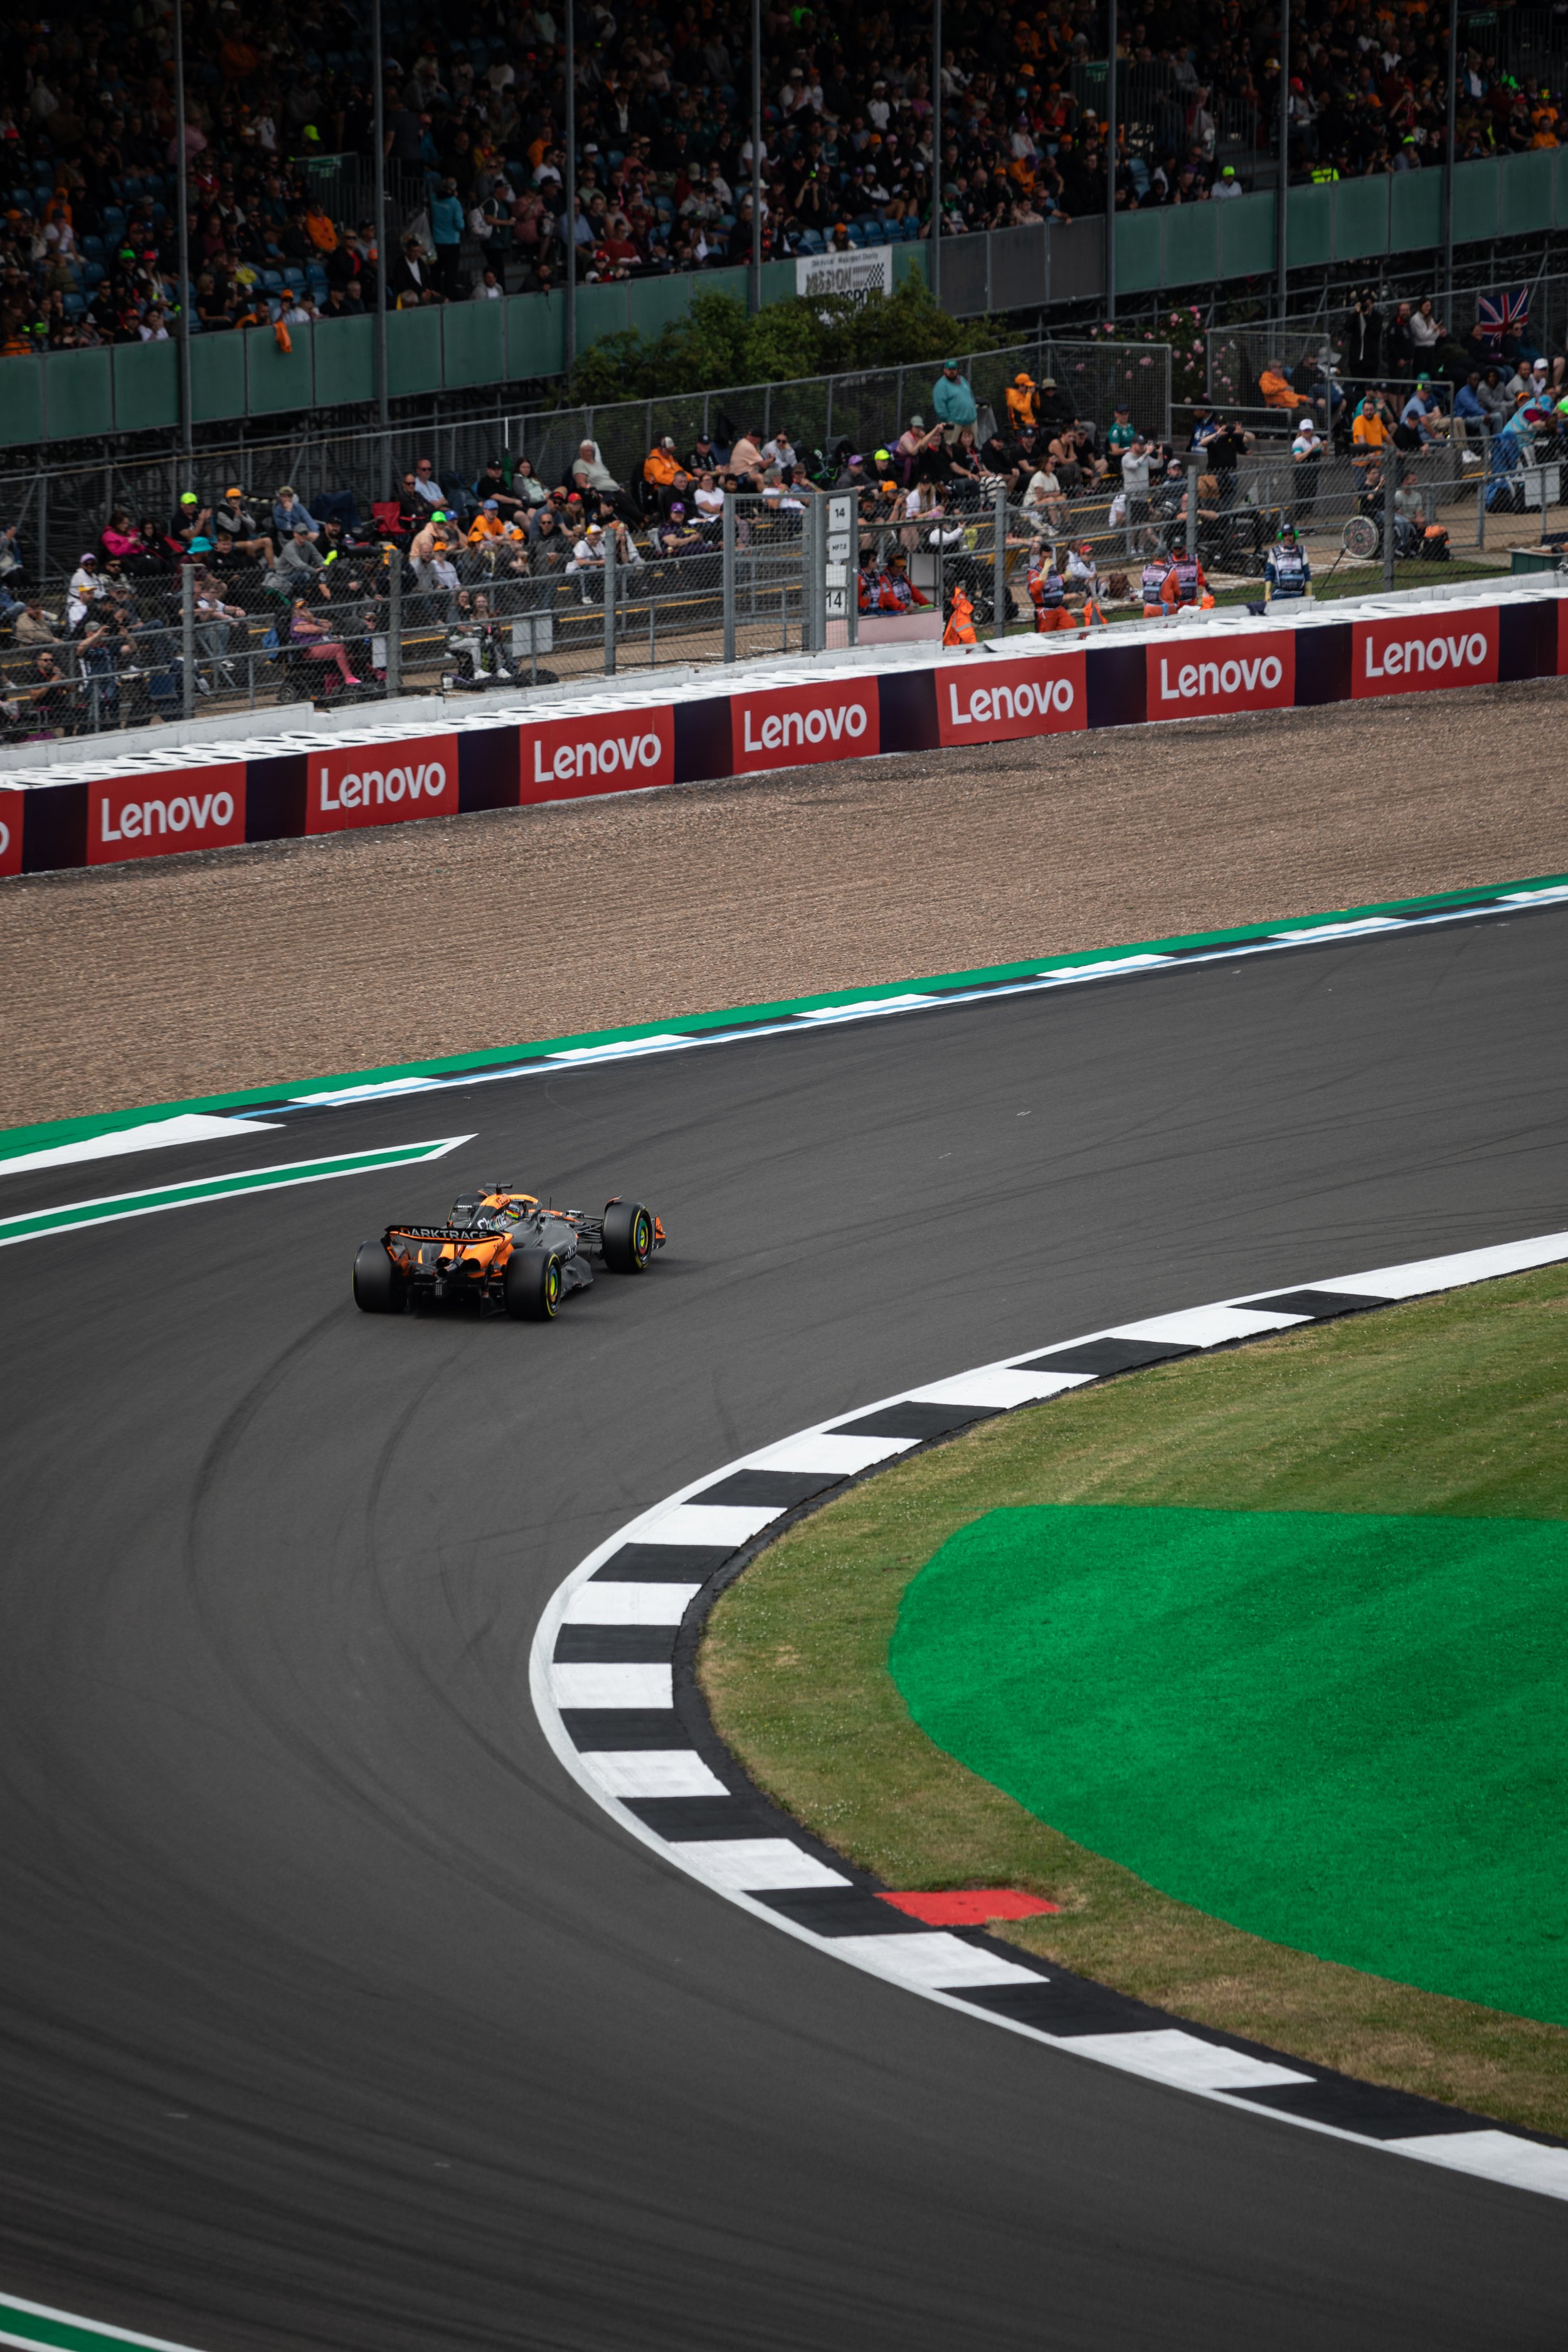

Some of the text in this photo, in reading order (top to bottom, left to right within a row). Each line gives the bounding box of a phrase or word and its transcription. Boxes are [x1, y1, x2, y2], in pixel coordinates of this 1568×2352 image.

[835, 507, 845, 518] 14
[825, 591, 842, 608] 14
[1161, 655, 1283, 700] Lenovo
[1367, 633, 1487, 677] Lenovo
[950, 679, 1074, 725] Lenovo
[744, 704, 867, 752] Lenovo
[534, 733, 662, 783] Lenovo
[321, 762, 446, 811] Lenovo
[102, 792, 234, 842] Lenovo
[477, 1212, 507, 1231] Chrome
